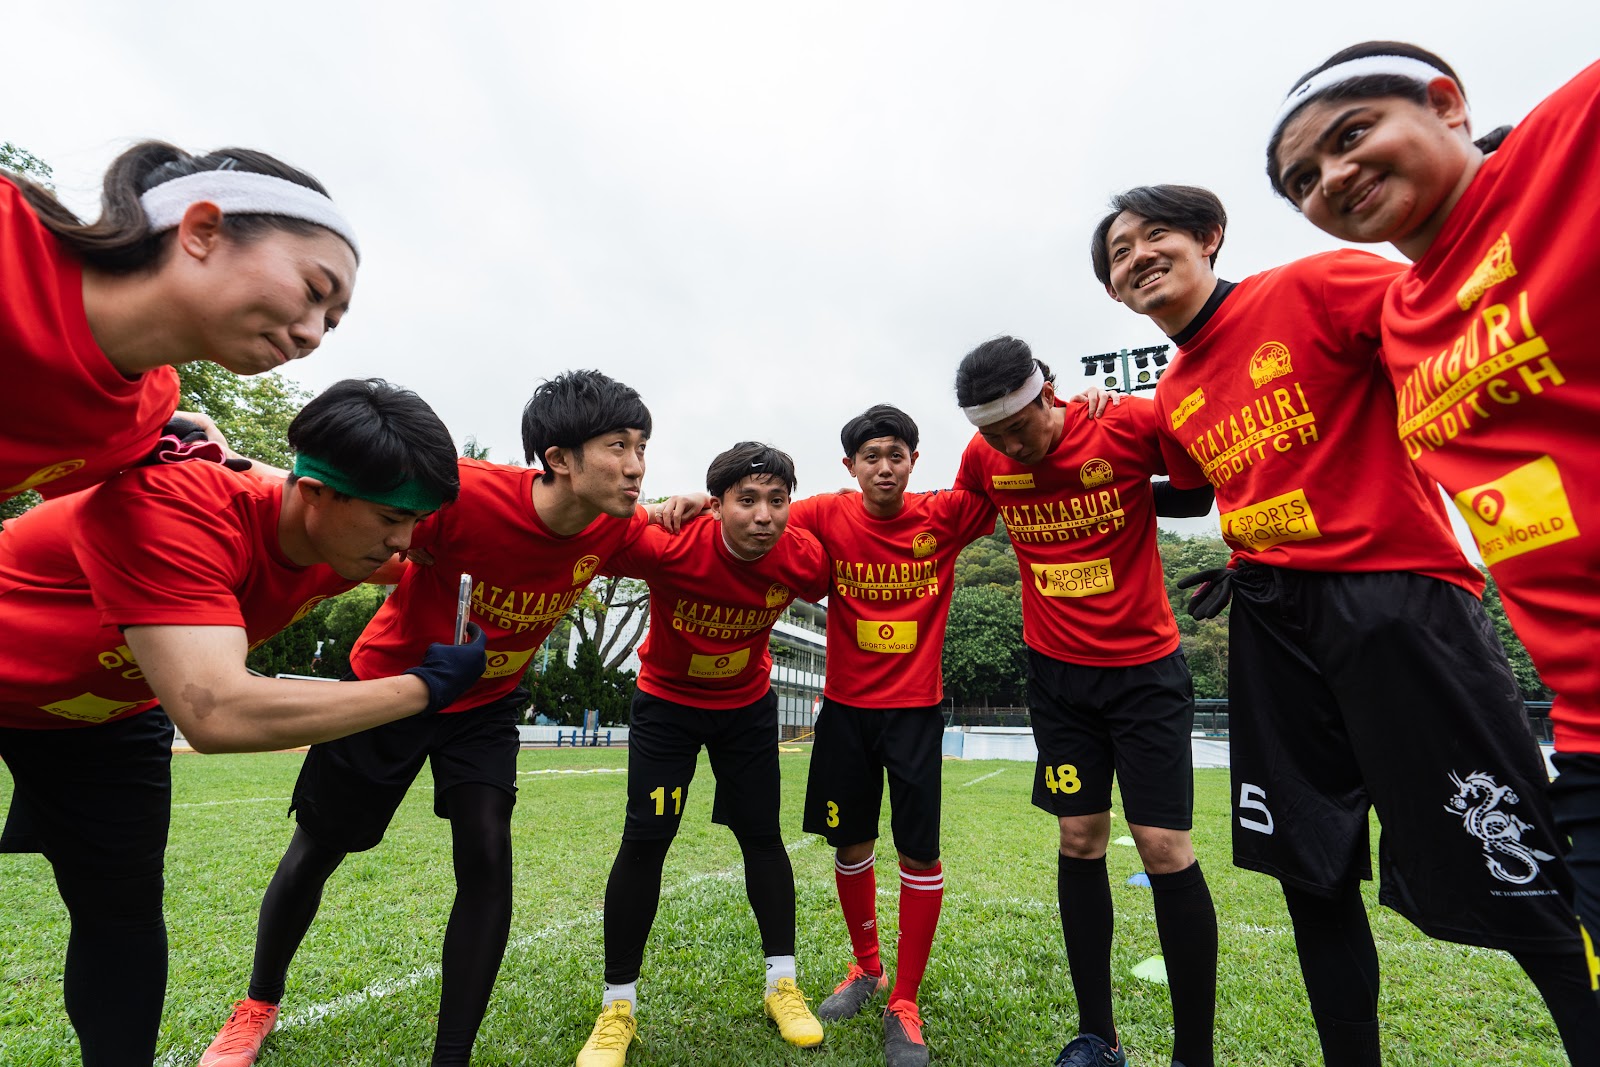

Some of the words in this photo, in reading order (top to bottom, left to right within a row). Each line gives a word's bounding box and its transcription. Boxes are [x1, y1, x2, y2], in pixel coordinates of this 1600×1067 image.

[1475, 352, 1516, 380] 2018
[1403, 356, 1567, 461] UIDDITCH
[1238, 431, 1264, 449] SINCE
[1269, 418, 1298, 434] 2018
[1208, 424, 1319, 489] UIDDITCH
[1001, 488, 1122, 526] KATAYABURI
[1010, 516, 1126, 543] QUIDDITCH
[1038, 523, 1063, 531] JAPAN
[1066, 518, 1091, 528] SINCE
[1238, 514, 1309, 546] PROJECT
[1503, 516, 1565, 546] WORLD
[836, 559, 938, 583] KATAYABURI
[1052, 575, 1110, 592] PROJECT
[472, 581, 582, 616] ATAYABUR
[837, 583, 939, 601] QUIDDITCH
[473, 603, 561, 635] UIDDITC
[860, 641, 887, 650] SPORTS
[888, 642, 915, 650] WORLD
[1044, 763, 1082, 795] 48
[649, 786, 682, 816] 11
[826, 800, 840, 828] 3
[1238, 782, 1275, 836] 5
